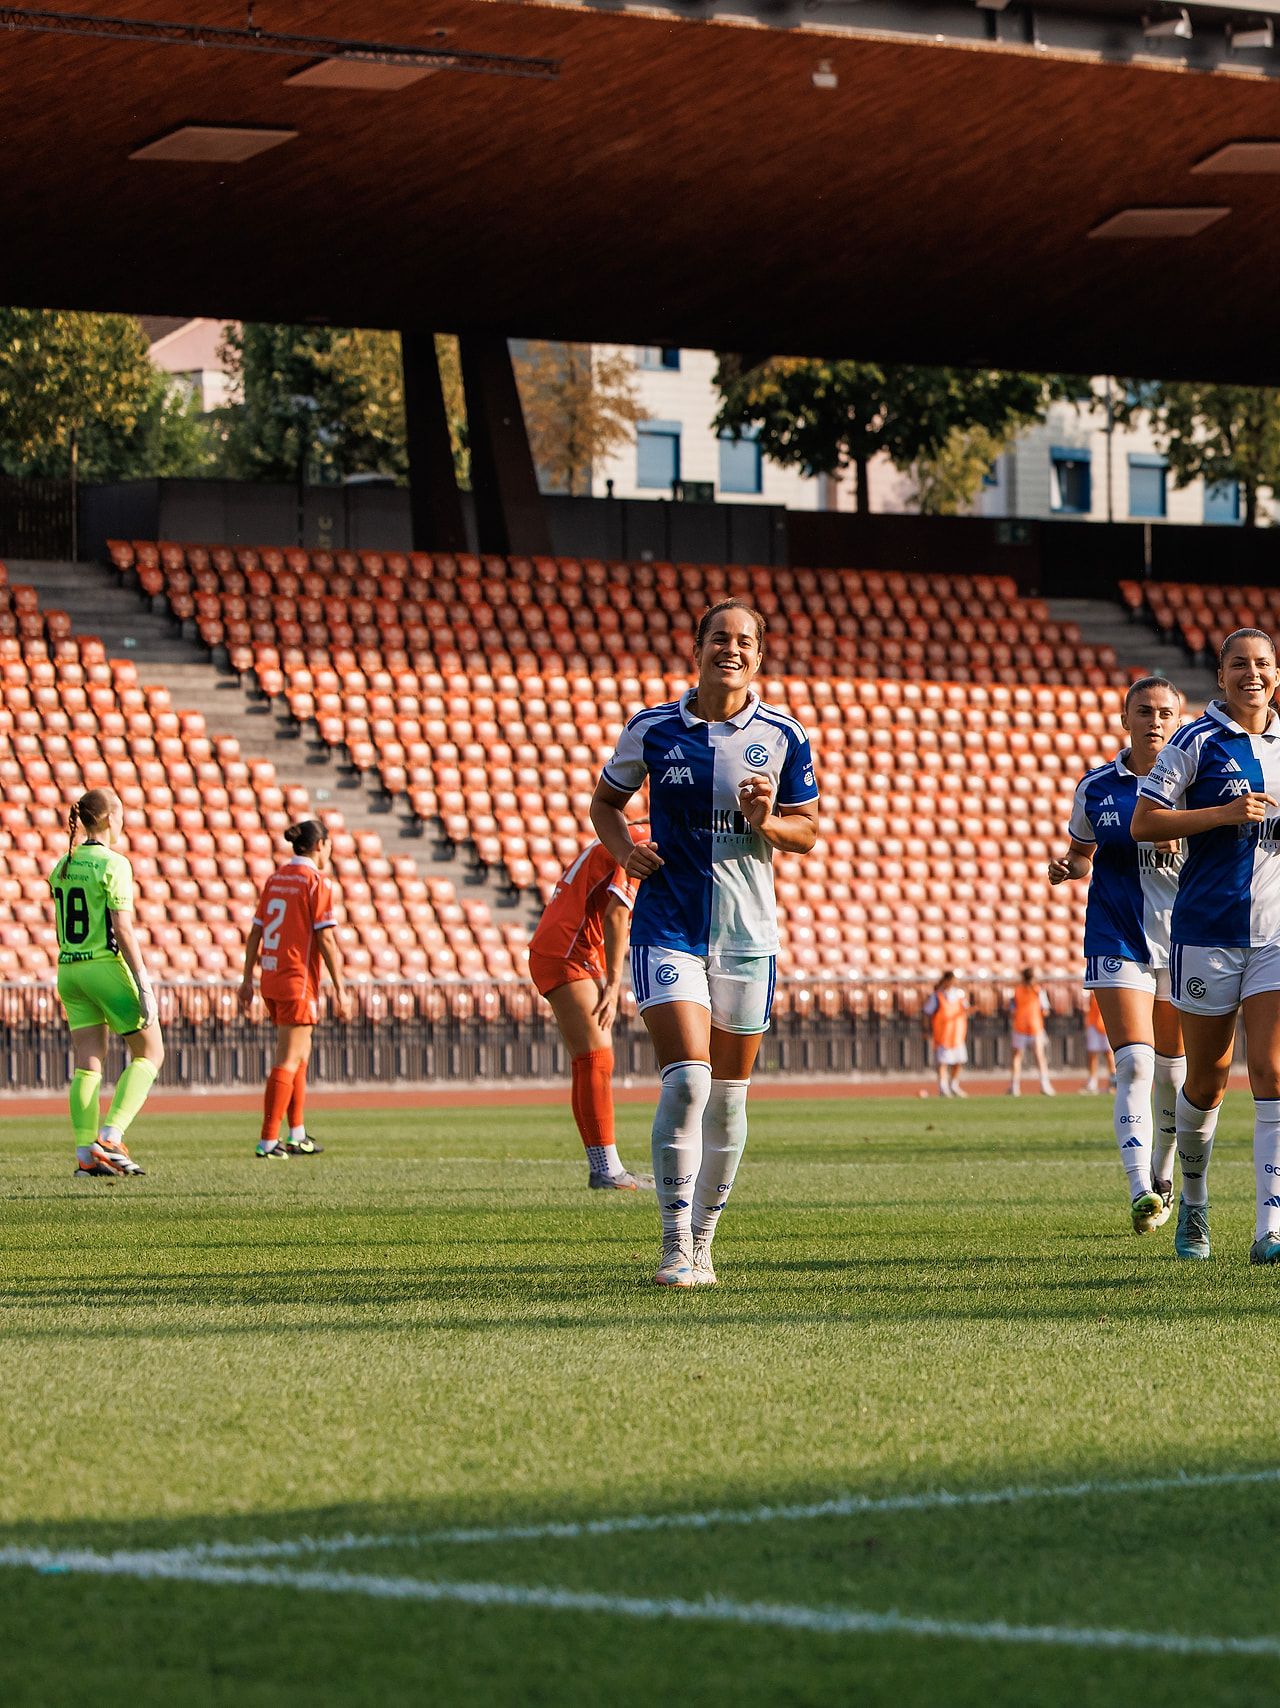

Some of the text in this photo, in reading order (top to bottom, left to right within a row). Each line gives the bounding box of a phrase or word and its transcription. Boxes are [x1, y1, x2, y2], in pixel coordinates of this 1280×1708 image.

[660, 766, 694, 784] AXA
[1218, 778, 1251, 796] AXA
[1097, 811, 1121, 827] AXA
[55, 887, 89, 944] 18
[264, 898, 287, 950] 2
[1120, 1115, 1142, 1124] GCZ
[1162, 1109, 1176, 1118] GC
[1178, 1151, 1204, 1163] GCZ
[663, 1174, 693, 1186] GCZ
[717, 1182, 734, 1193] GC
